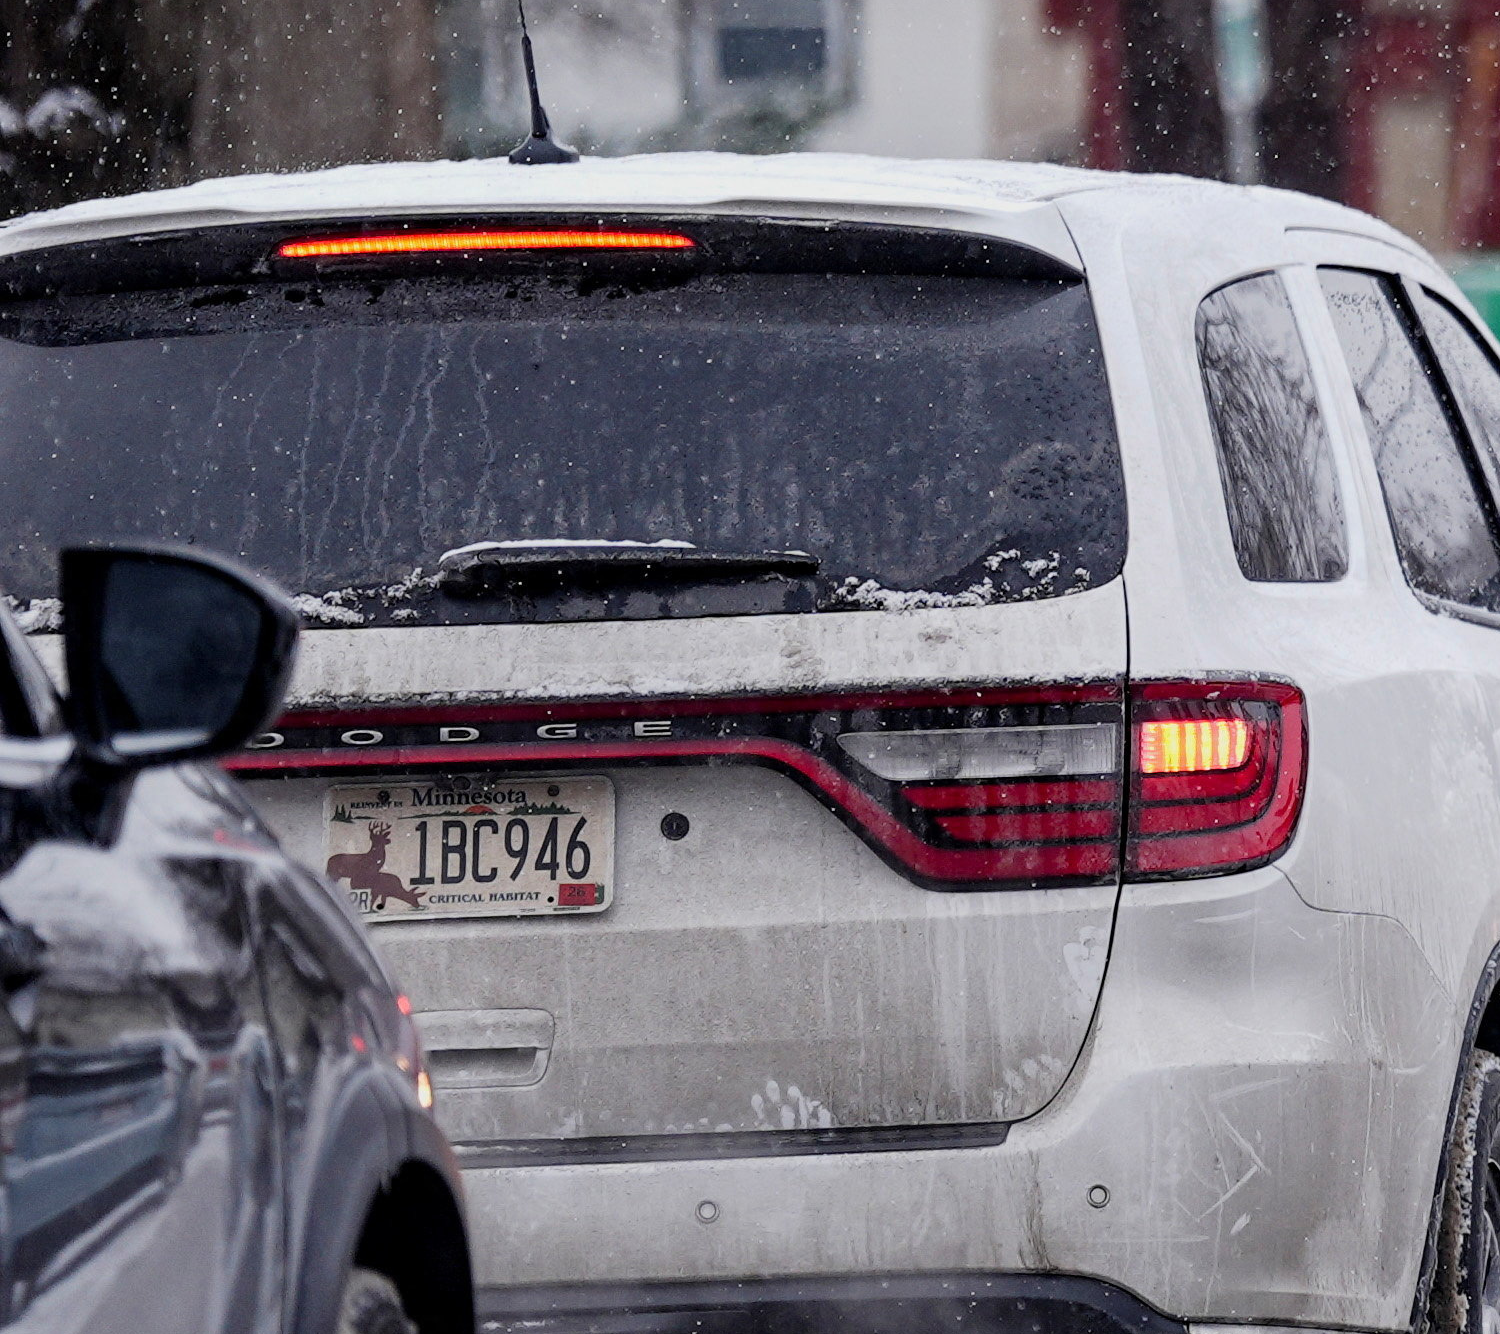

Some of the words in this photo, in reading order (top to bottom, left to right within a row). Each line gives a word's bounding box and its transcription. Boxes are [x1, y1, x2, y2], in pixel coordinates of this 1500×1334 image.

[245, 720, 672, 749] DODGE
[411, 788, 527, 807] Minnesota
[409, 816, 591, 886] 1BC946
[428, 893, 486, 904] CRITICAL
[488, 891, 541, 903] HABITAT
